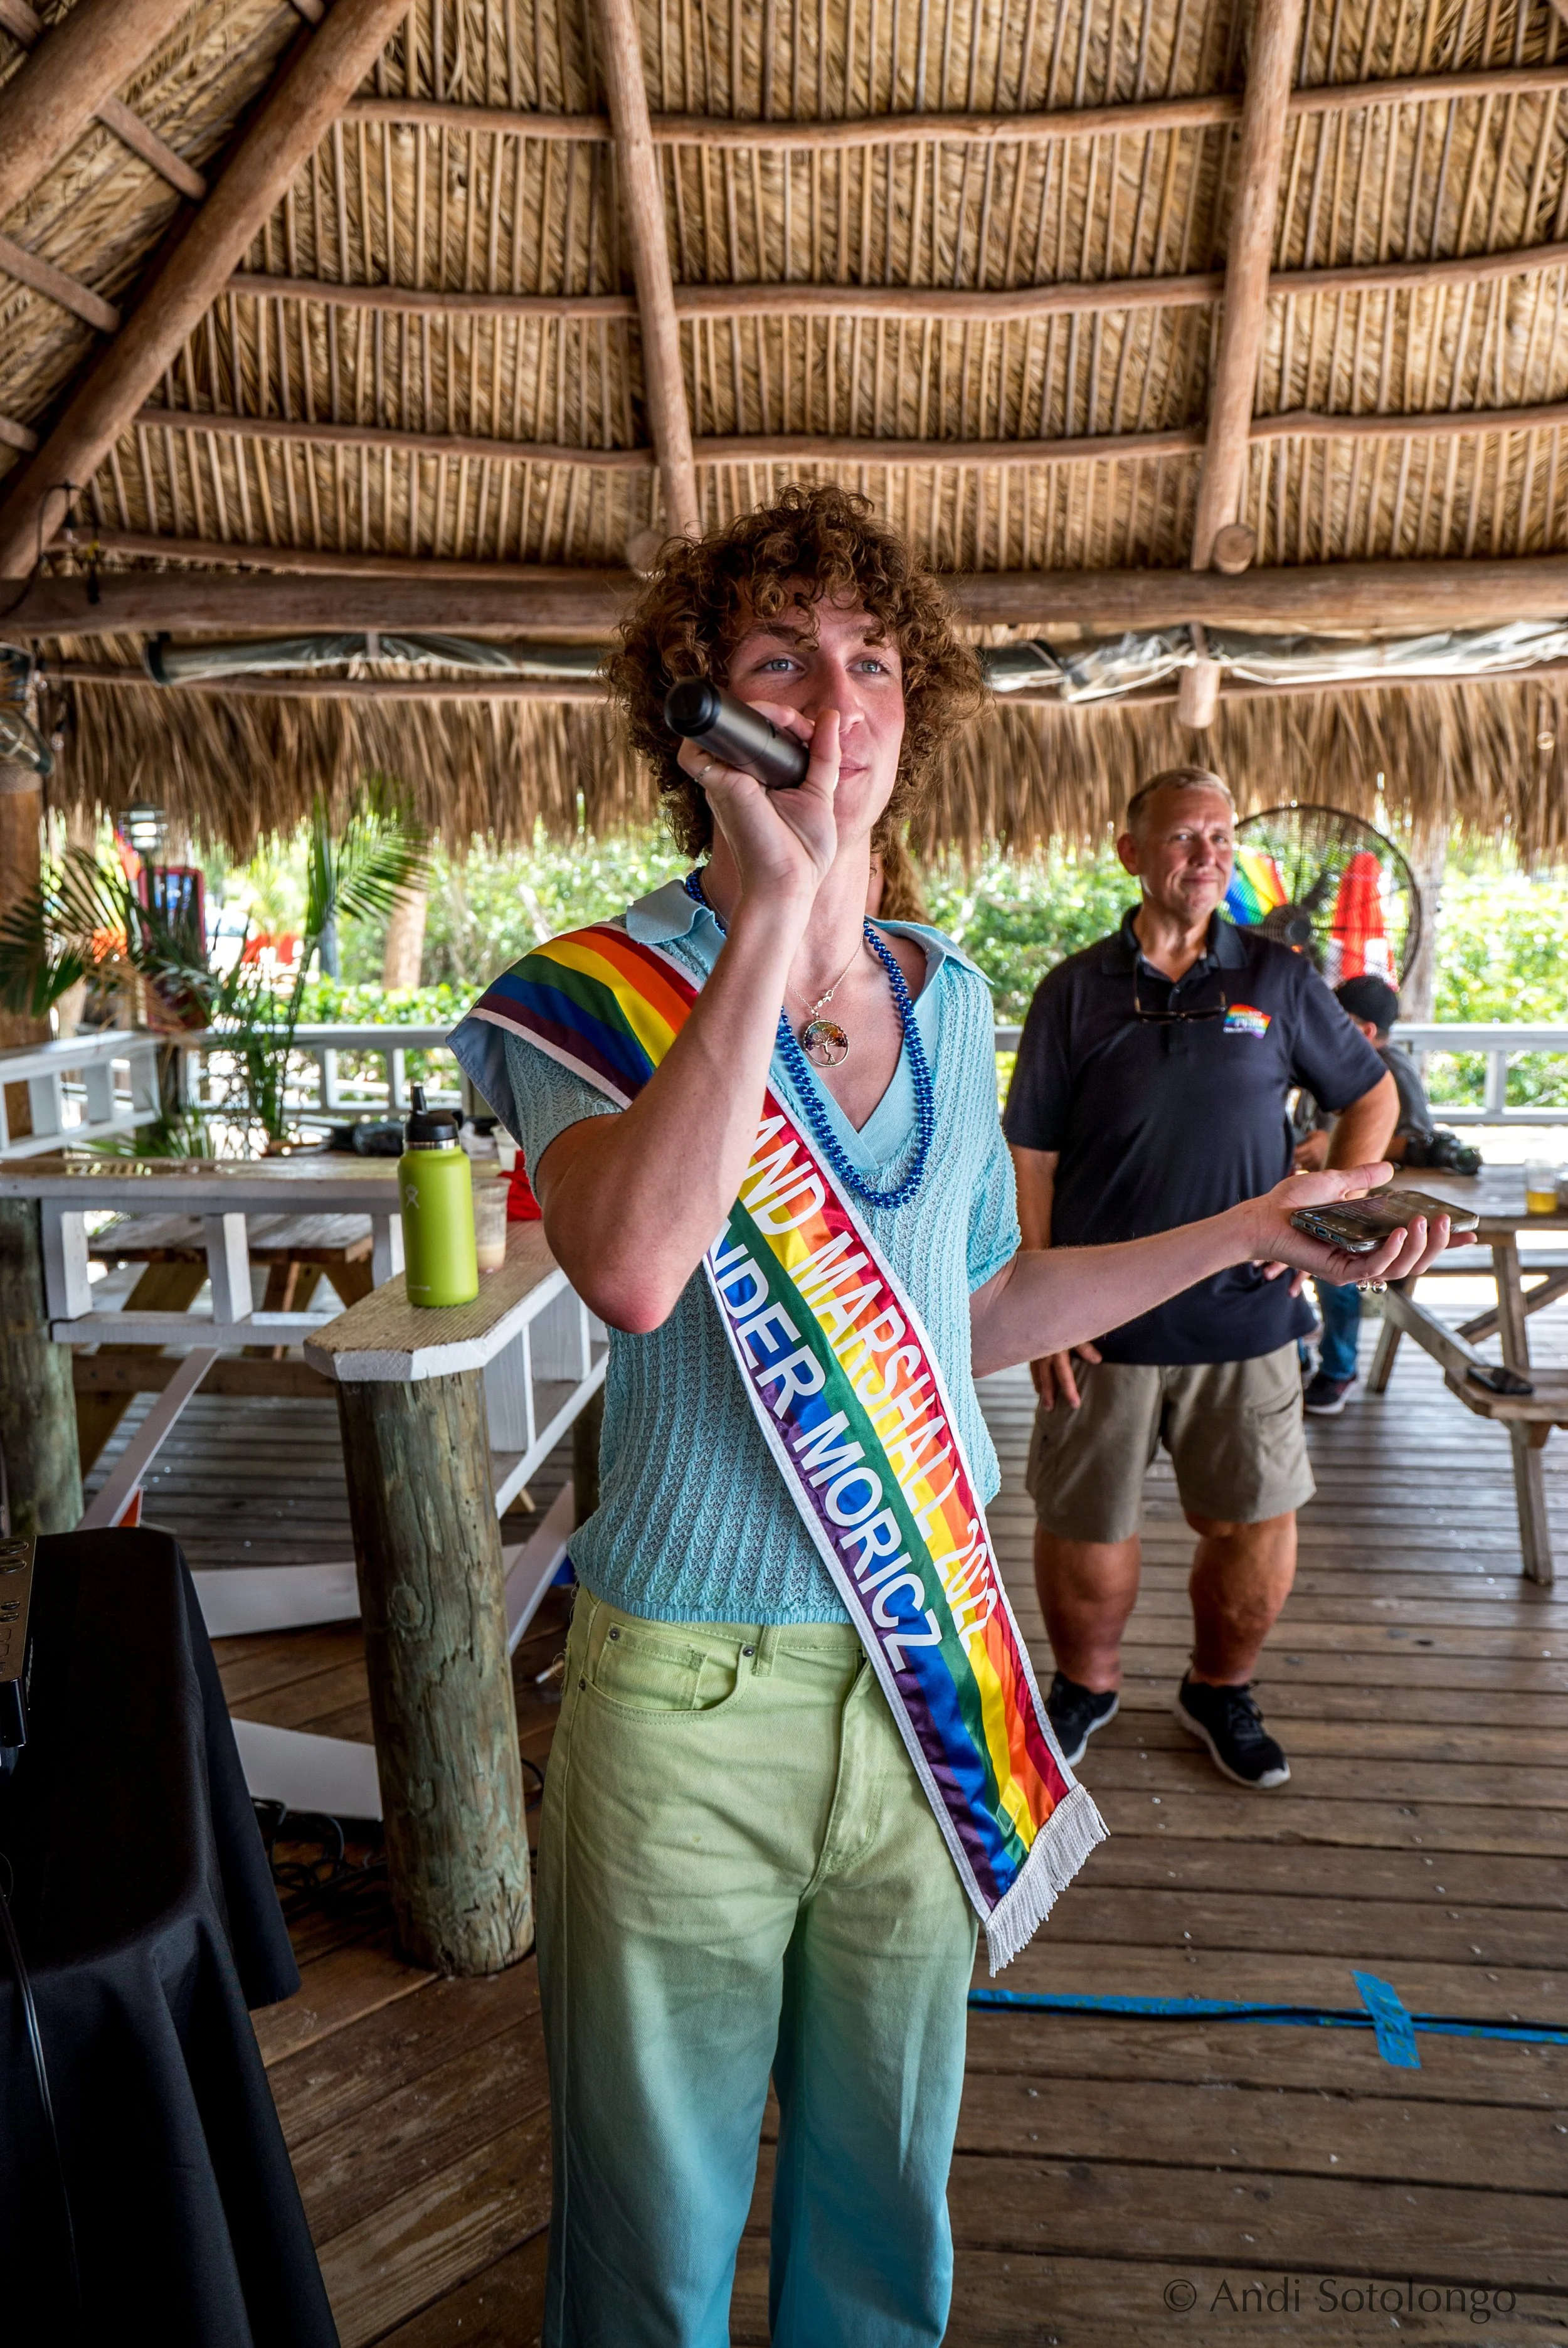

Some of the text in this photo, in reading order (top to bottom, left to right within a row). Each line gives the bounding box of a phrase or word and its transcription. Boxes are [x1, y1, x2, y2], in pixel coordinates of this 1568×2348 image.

[787, 1230, 960, 1541] MARSHALL
[933, 1517, 997, 1657] 2022
[793, 1410, 943, 1672] MORICZ
